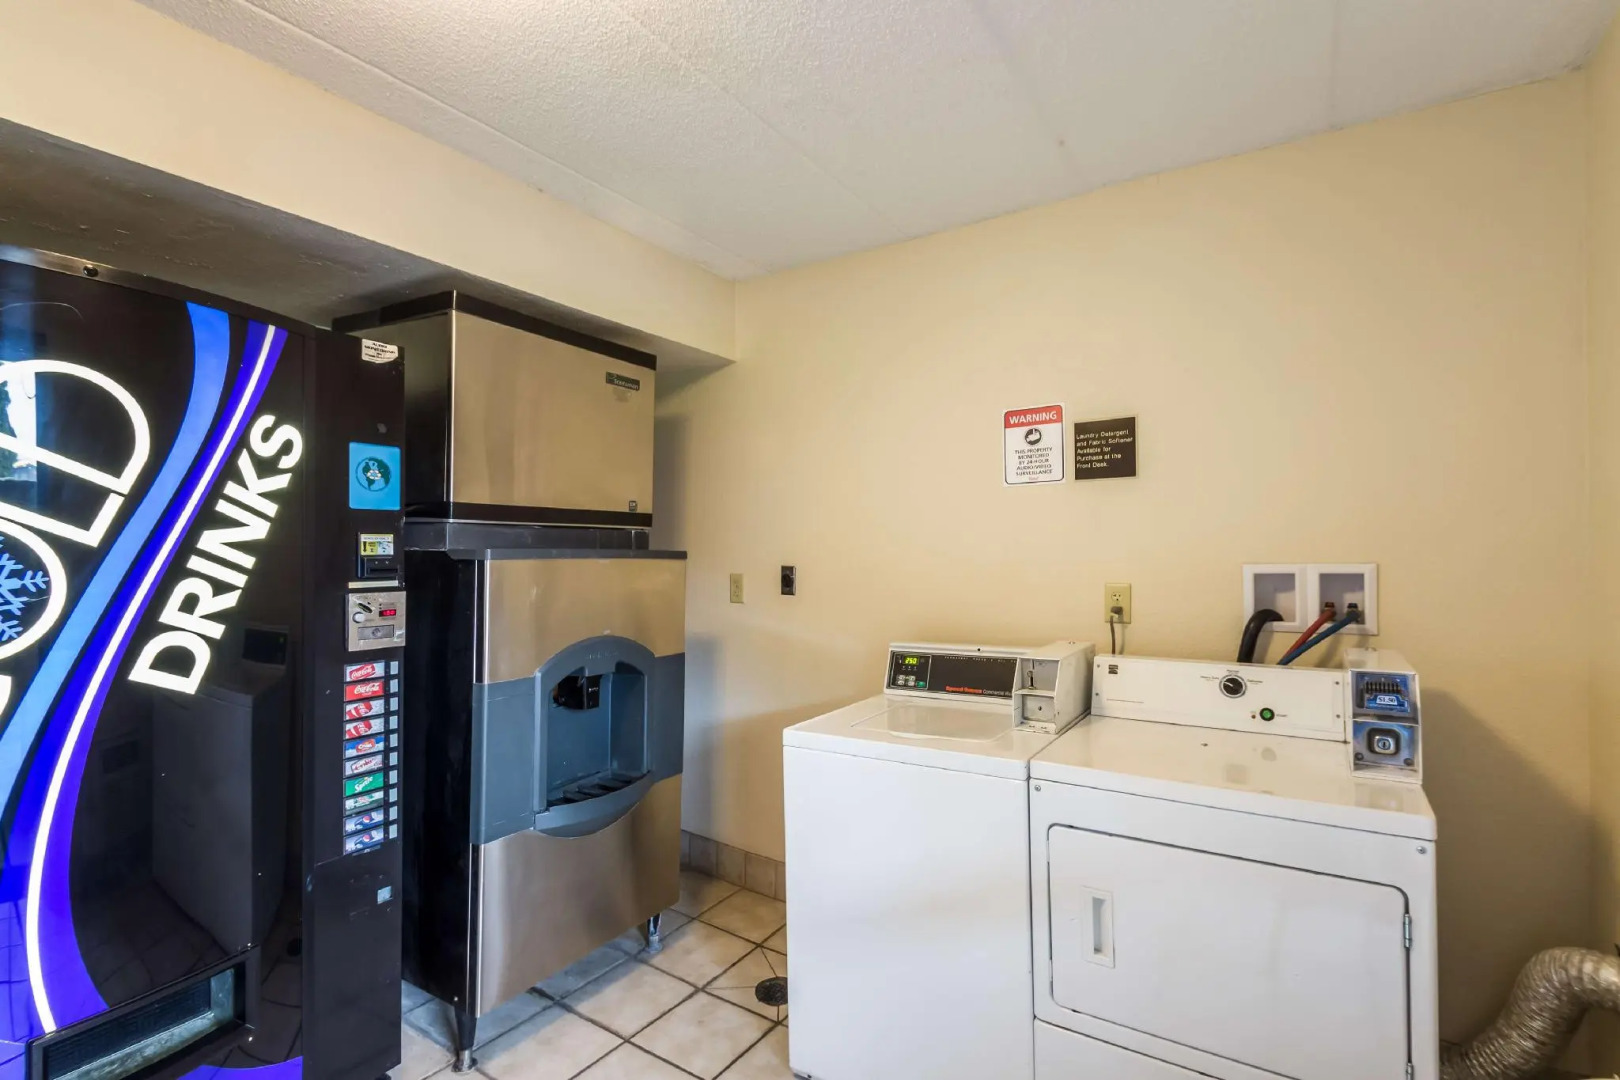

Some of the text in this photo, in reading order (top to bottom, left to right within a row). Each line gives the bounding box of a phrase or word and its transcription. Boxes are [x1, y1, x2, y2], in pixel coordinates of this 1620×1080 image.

[1009, 411, 1057, 425] WARNING
[1100, 429, 1129, 437] Detergent
[1026, 446, 1053, 454] PROPERTY
[128, 414, 303, 695] DRINKS
